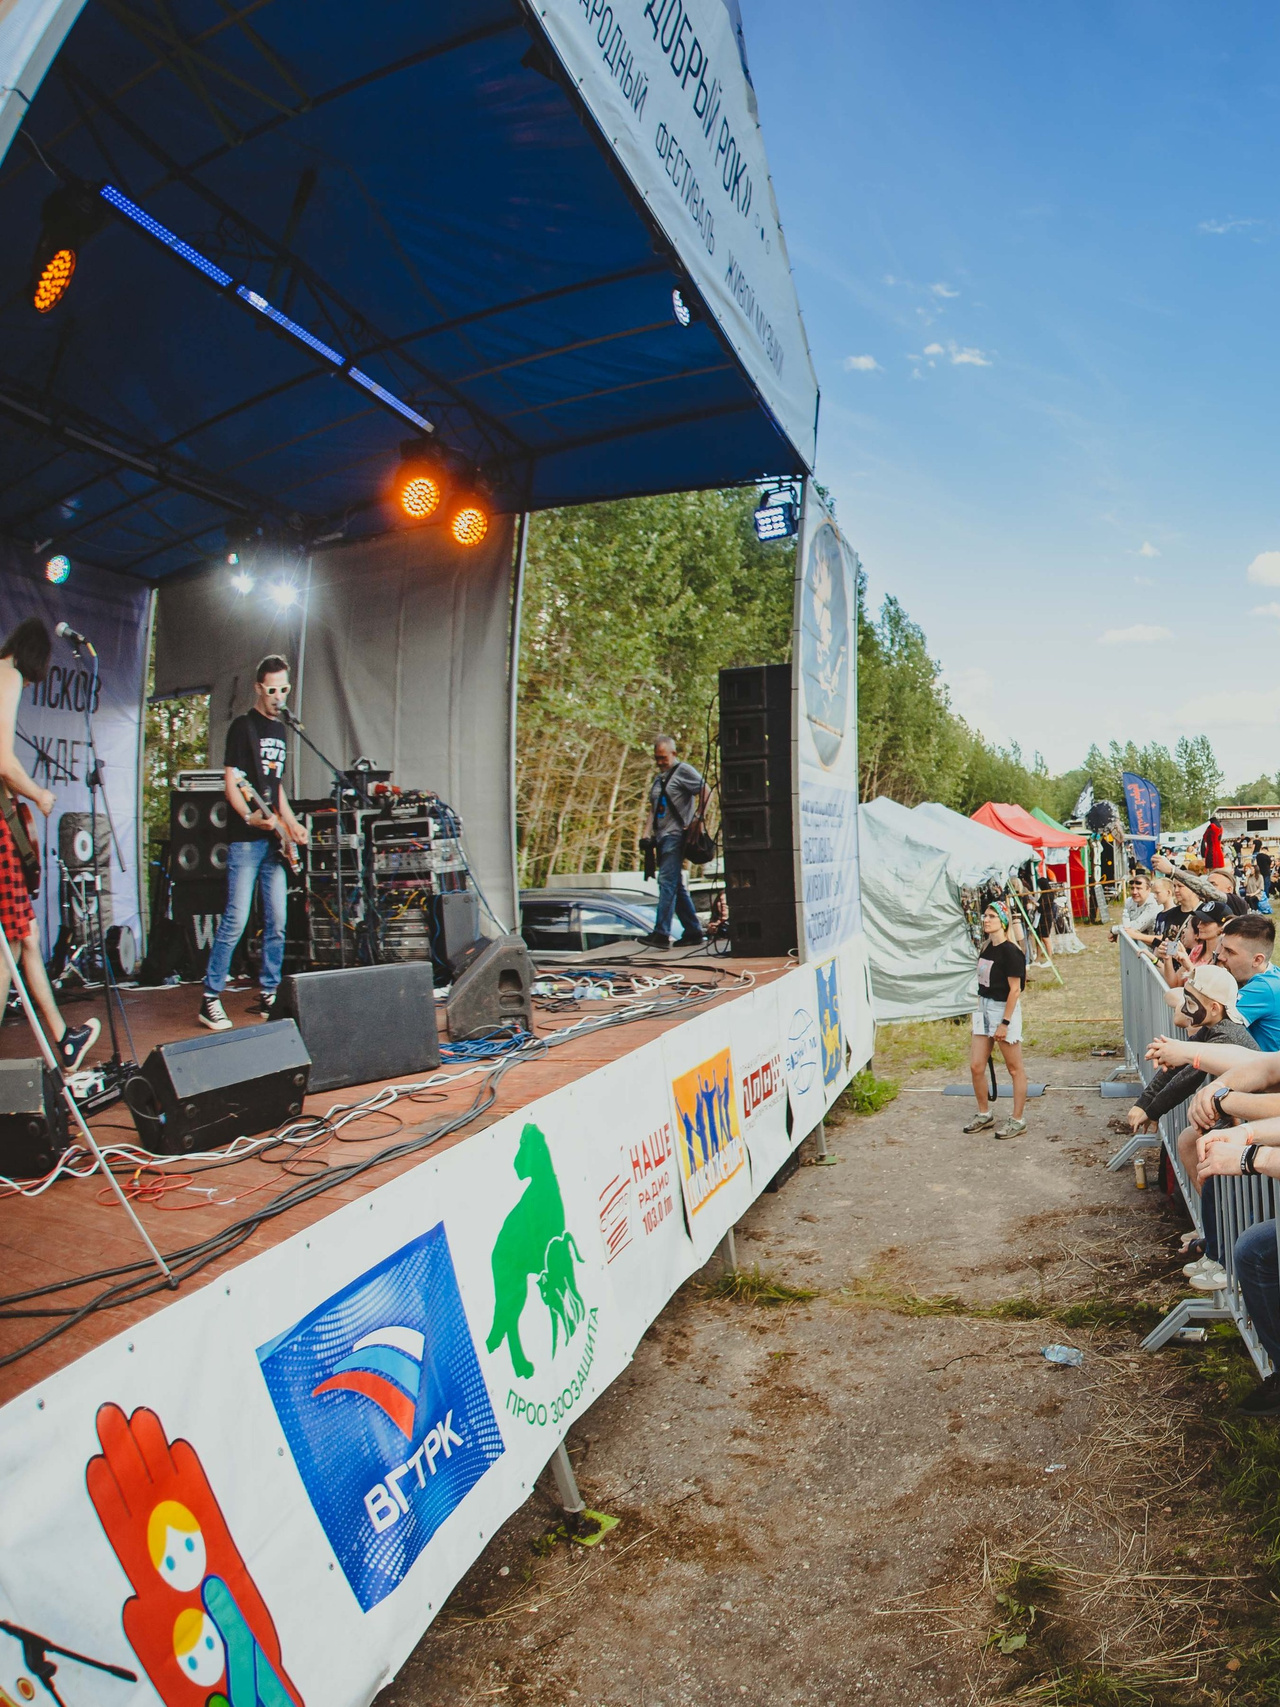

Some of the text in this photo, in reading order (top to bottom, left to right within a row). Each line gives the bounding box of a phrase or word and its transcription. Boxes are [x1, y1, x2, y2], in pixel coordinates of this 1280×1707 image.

[655, 121, 716, 256] ФЕСТИВАЛЬ
[724, 249, 756, 325] ЖИВОЙ
[629, 1122, 672, 1183] НАШЕ
[638, 1171, 670, 1209] РАДИО
[506, 1307, 599, 1427] ПРОО ЗООЗАЩИТА
[363, 1409, 464, 1534] ВГТРК
